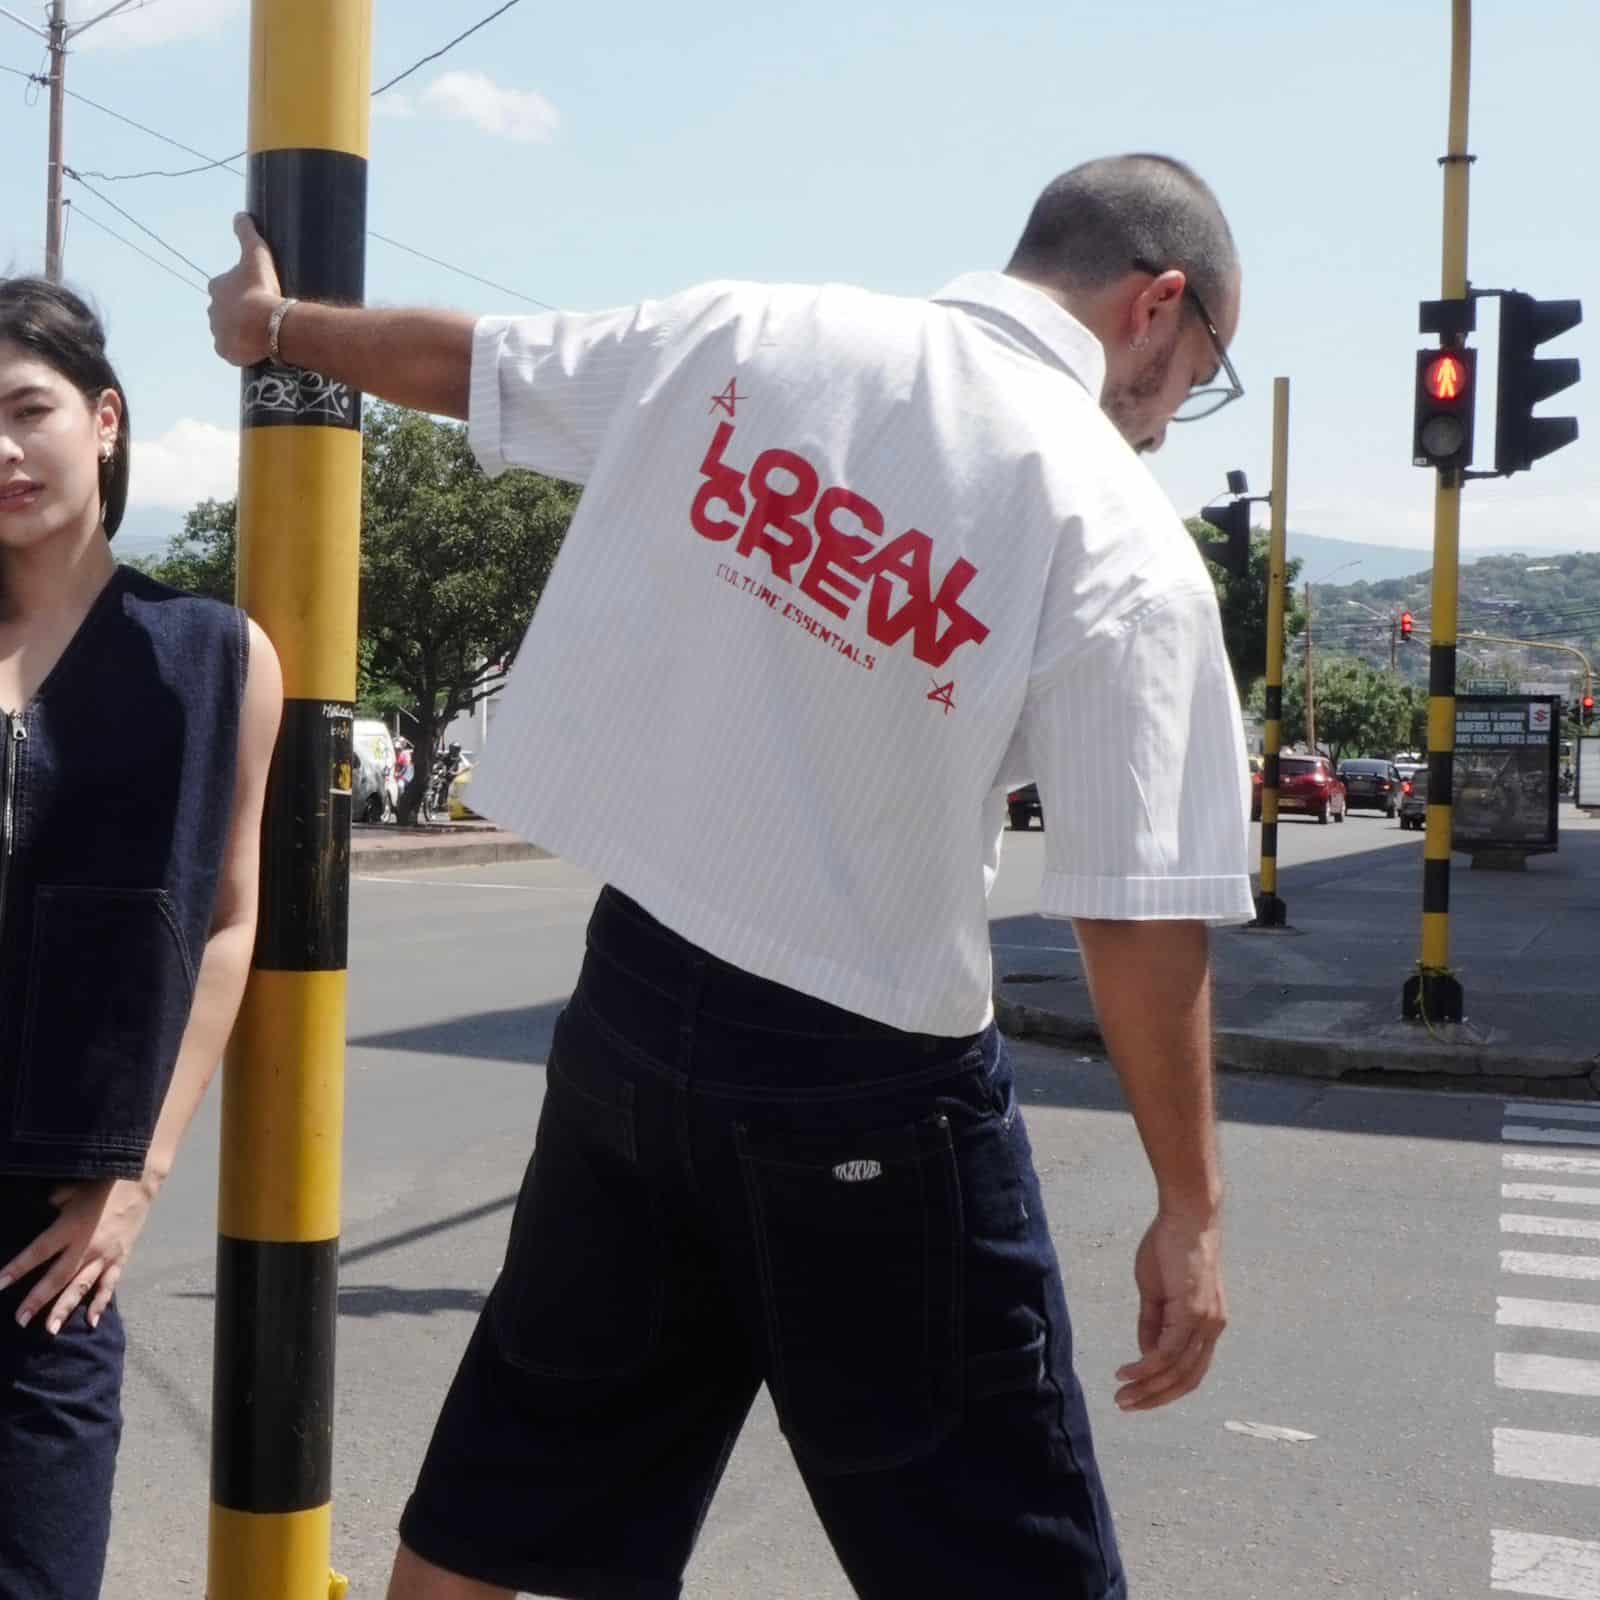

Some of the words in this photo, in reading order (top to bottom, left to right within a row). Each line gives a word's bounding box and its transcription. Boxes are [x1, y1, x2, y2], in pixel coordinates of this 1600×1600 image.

[690, 473, 979, 668] CREW
[699, 420, 991, 645] LOCAL
[716, 563, 782, 610] CULTURE
[782, 602, 876, 670] ESSENTIALS
